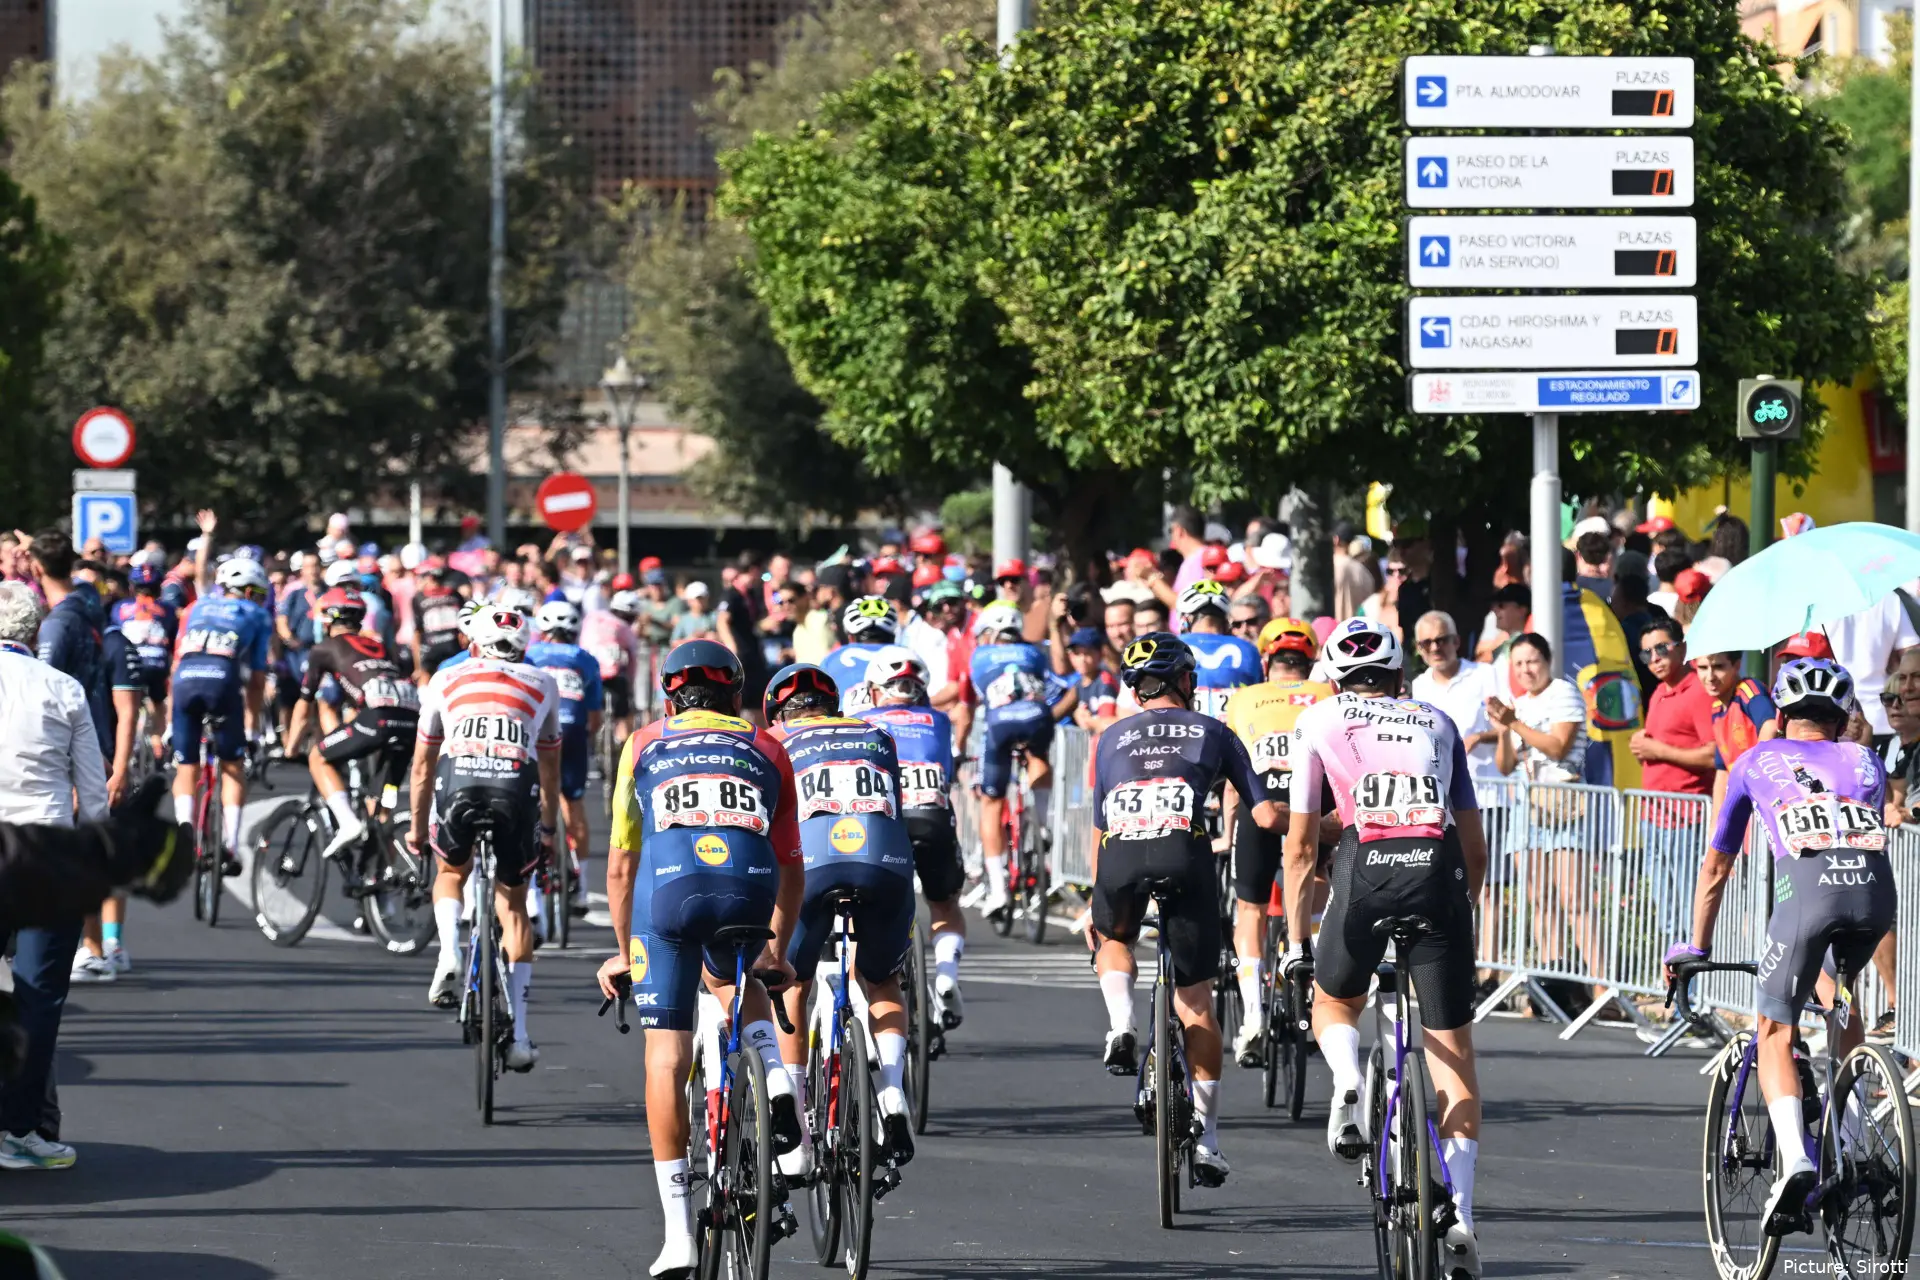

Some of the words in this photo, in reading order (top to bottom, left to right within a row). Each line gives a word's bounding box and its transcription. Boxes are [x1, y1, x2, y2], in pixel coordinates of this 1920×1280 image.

[1616, 71, 1670, 83] PLAZAS
[1490, 85, 1581, 98] ALMODOVAR
[1457, 156, 1505, 168] PASEO
[1510, 155, 1529, 168] DE
[1532, 155, 1549, 168] LA
[1616, 151, 1670, 163] PLAZAS
[1457, 177, 1522, 189] VICTORIA
[1459, 235, 1507, 248] PASEO
[1511, 235, 1576, 248] VICTORIA
[1619, 232, 1672, 244] PLAZAS
[1459, 255, 1486, 269] (VIA
[1489, 255, 1559, 269] SERVICIO)
[1508, 315, 1587, 328] HIROSHIMA
[1591, 315, 1601, 327] Y
[1620, 310, 1673, 322] PLAZAS
[1460, 336, 1532, 349] NAGASAKI
[1550, 380, 1649, 392] ESTACIONAMIENTO
[1570, 392, 1630, 403] REGULADO
[87, 500, 123, 538] P
[1344, 708, 1434, 729] Burpellet
[1147, 724, 1205, 739] UBS
[1377, 734, 1412, 743] BH
[789, 741, 890, 763] servicenow
[1129, 746, 1183, 757] AMACX
[455, 757, 512, 770] BRUSTOR
[649, 753, 764, 777] servicenow
[1144, 760, 1164, 769] SGS
[1757, 751, 1793, 791] ALULA
[801, 768, 834, 801] 84
[855, 766, 888, 798] 84
[664, 781, 699, 813] 85
[719, 781, 757, 812] 85
[719, 812, 757, 828] NOEL
[1366, 848, 1434, 867] Burpellet
[1818, 872, 1877, 886] ALULA
[1758, 942, 1788, 988] ALULA
